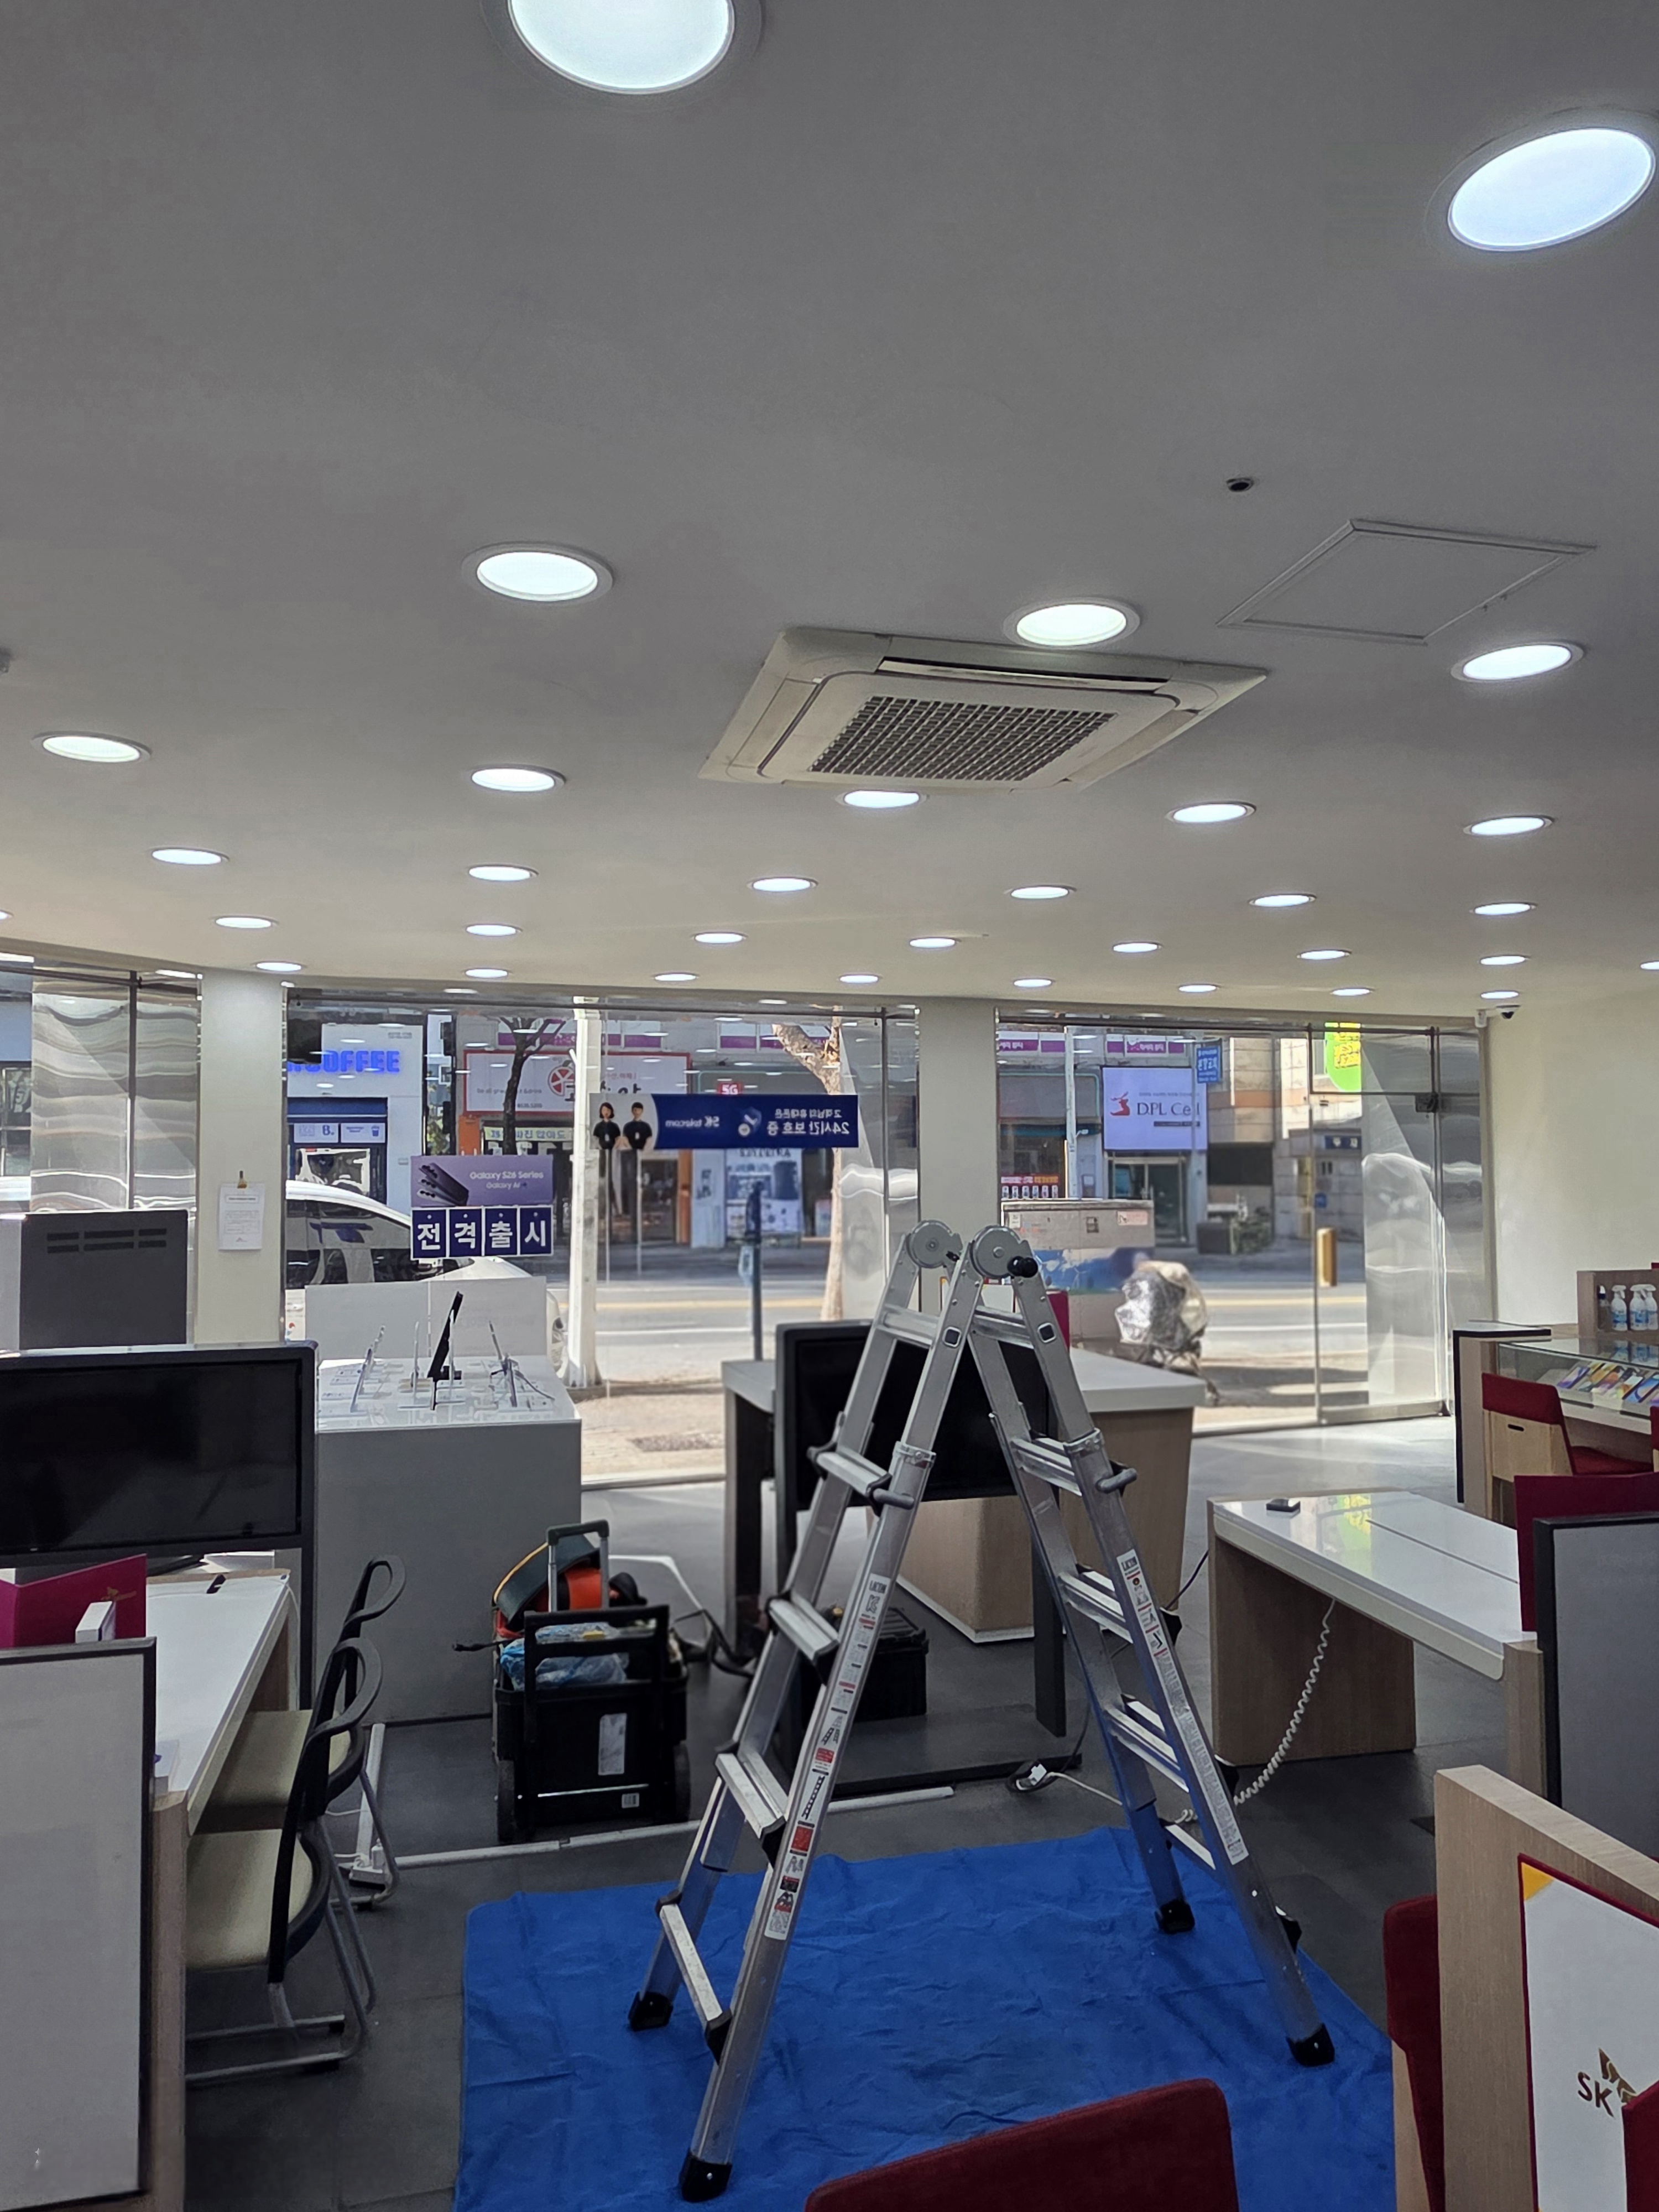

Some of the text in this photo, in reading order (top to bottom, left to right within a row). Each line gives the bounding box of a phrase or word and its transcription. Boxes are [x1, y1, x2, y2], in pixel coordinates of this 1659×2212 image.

[722, 1084, 739, 1094] 5G
[1171, 1102, 1200, 1116] Cel
[469, 1171, 501, 1181] Galaxy
[518, 1171, 544, 1179] Series
[486, 1182, 511, 1190] Galaxy
[1578, 2072, 1615, 2117] SK
